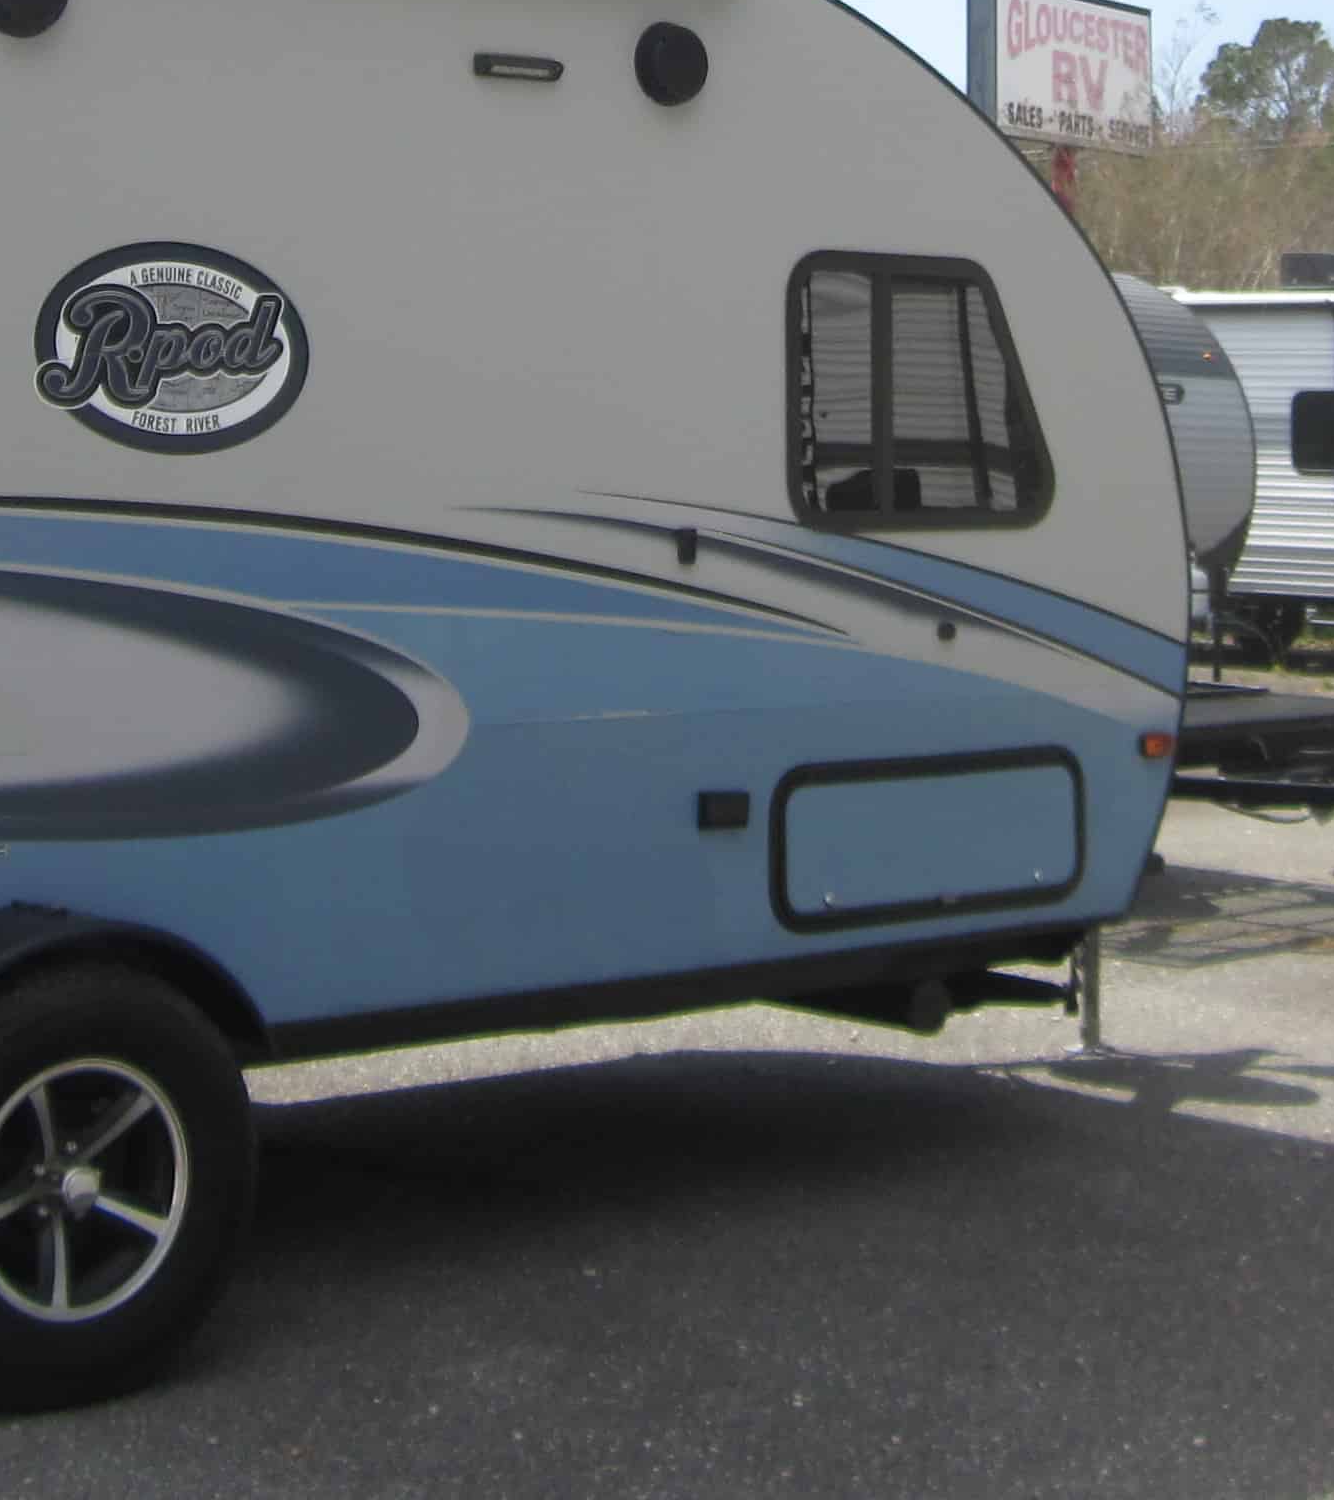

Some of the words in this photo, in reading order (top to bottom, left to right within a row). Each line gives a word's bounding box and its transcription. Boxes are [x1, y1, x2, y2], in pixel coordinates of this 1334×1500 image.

[1051, 50, 1109, 111] RV
[1006, 101, 1044, 129] SALES
[1058, 110, 1096, 138] PARTS
[130, 271, 139, 287] A
[141, 267, 193, 285] GENUINE
[196, 270, 244, 301] CLASSIC
[132, 410, 177, 433] FOREST
[185, 414, 221, 433] RIVER
